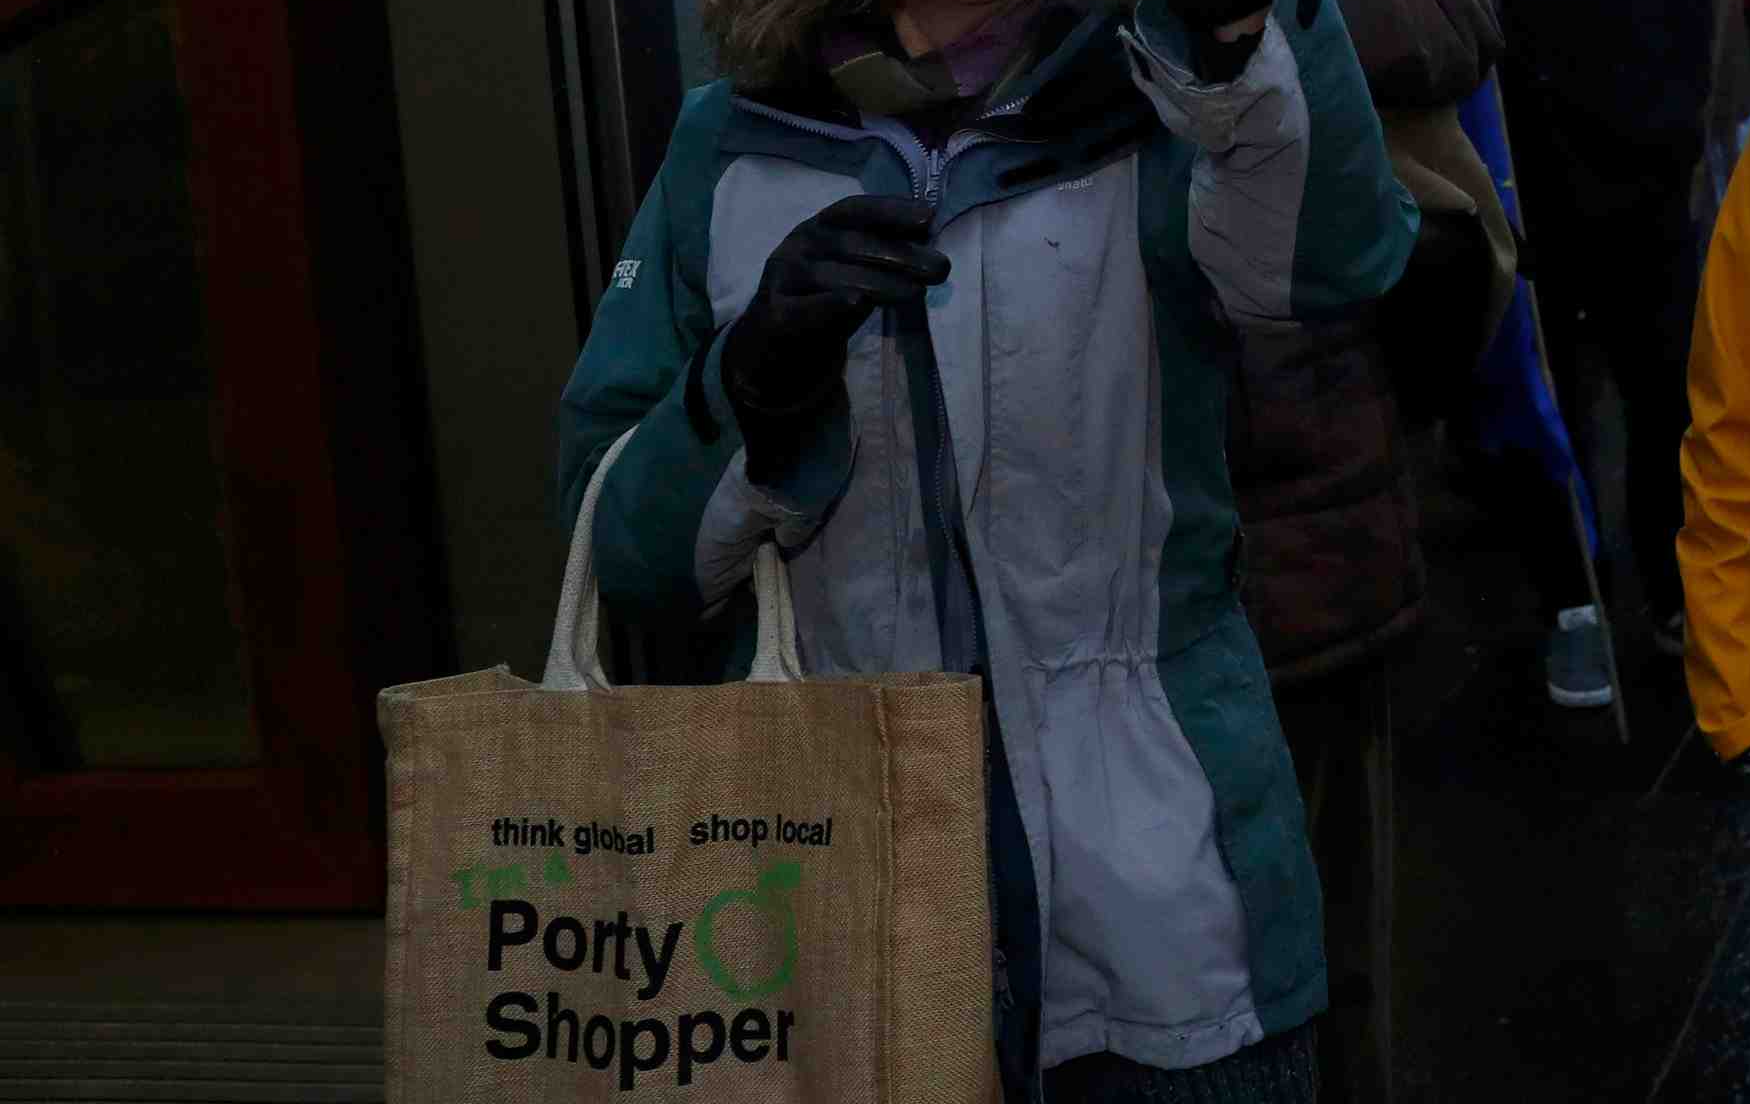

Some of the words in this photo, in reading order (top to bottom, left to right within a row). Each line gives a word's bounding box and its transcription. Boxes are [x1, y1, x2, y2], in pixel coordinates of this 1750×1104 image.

[491, 817, 565, 848] think
[574, 821, 655, 855] global
[689, 814, 769, 848] shop
[776, 813, 833, 847] local
[487, 899, 683, 1001] Porty
[485, 991, 796, 1092] Shopper
